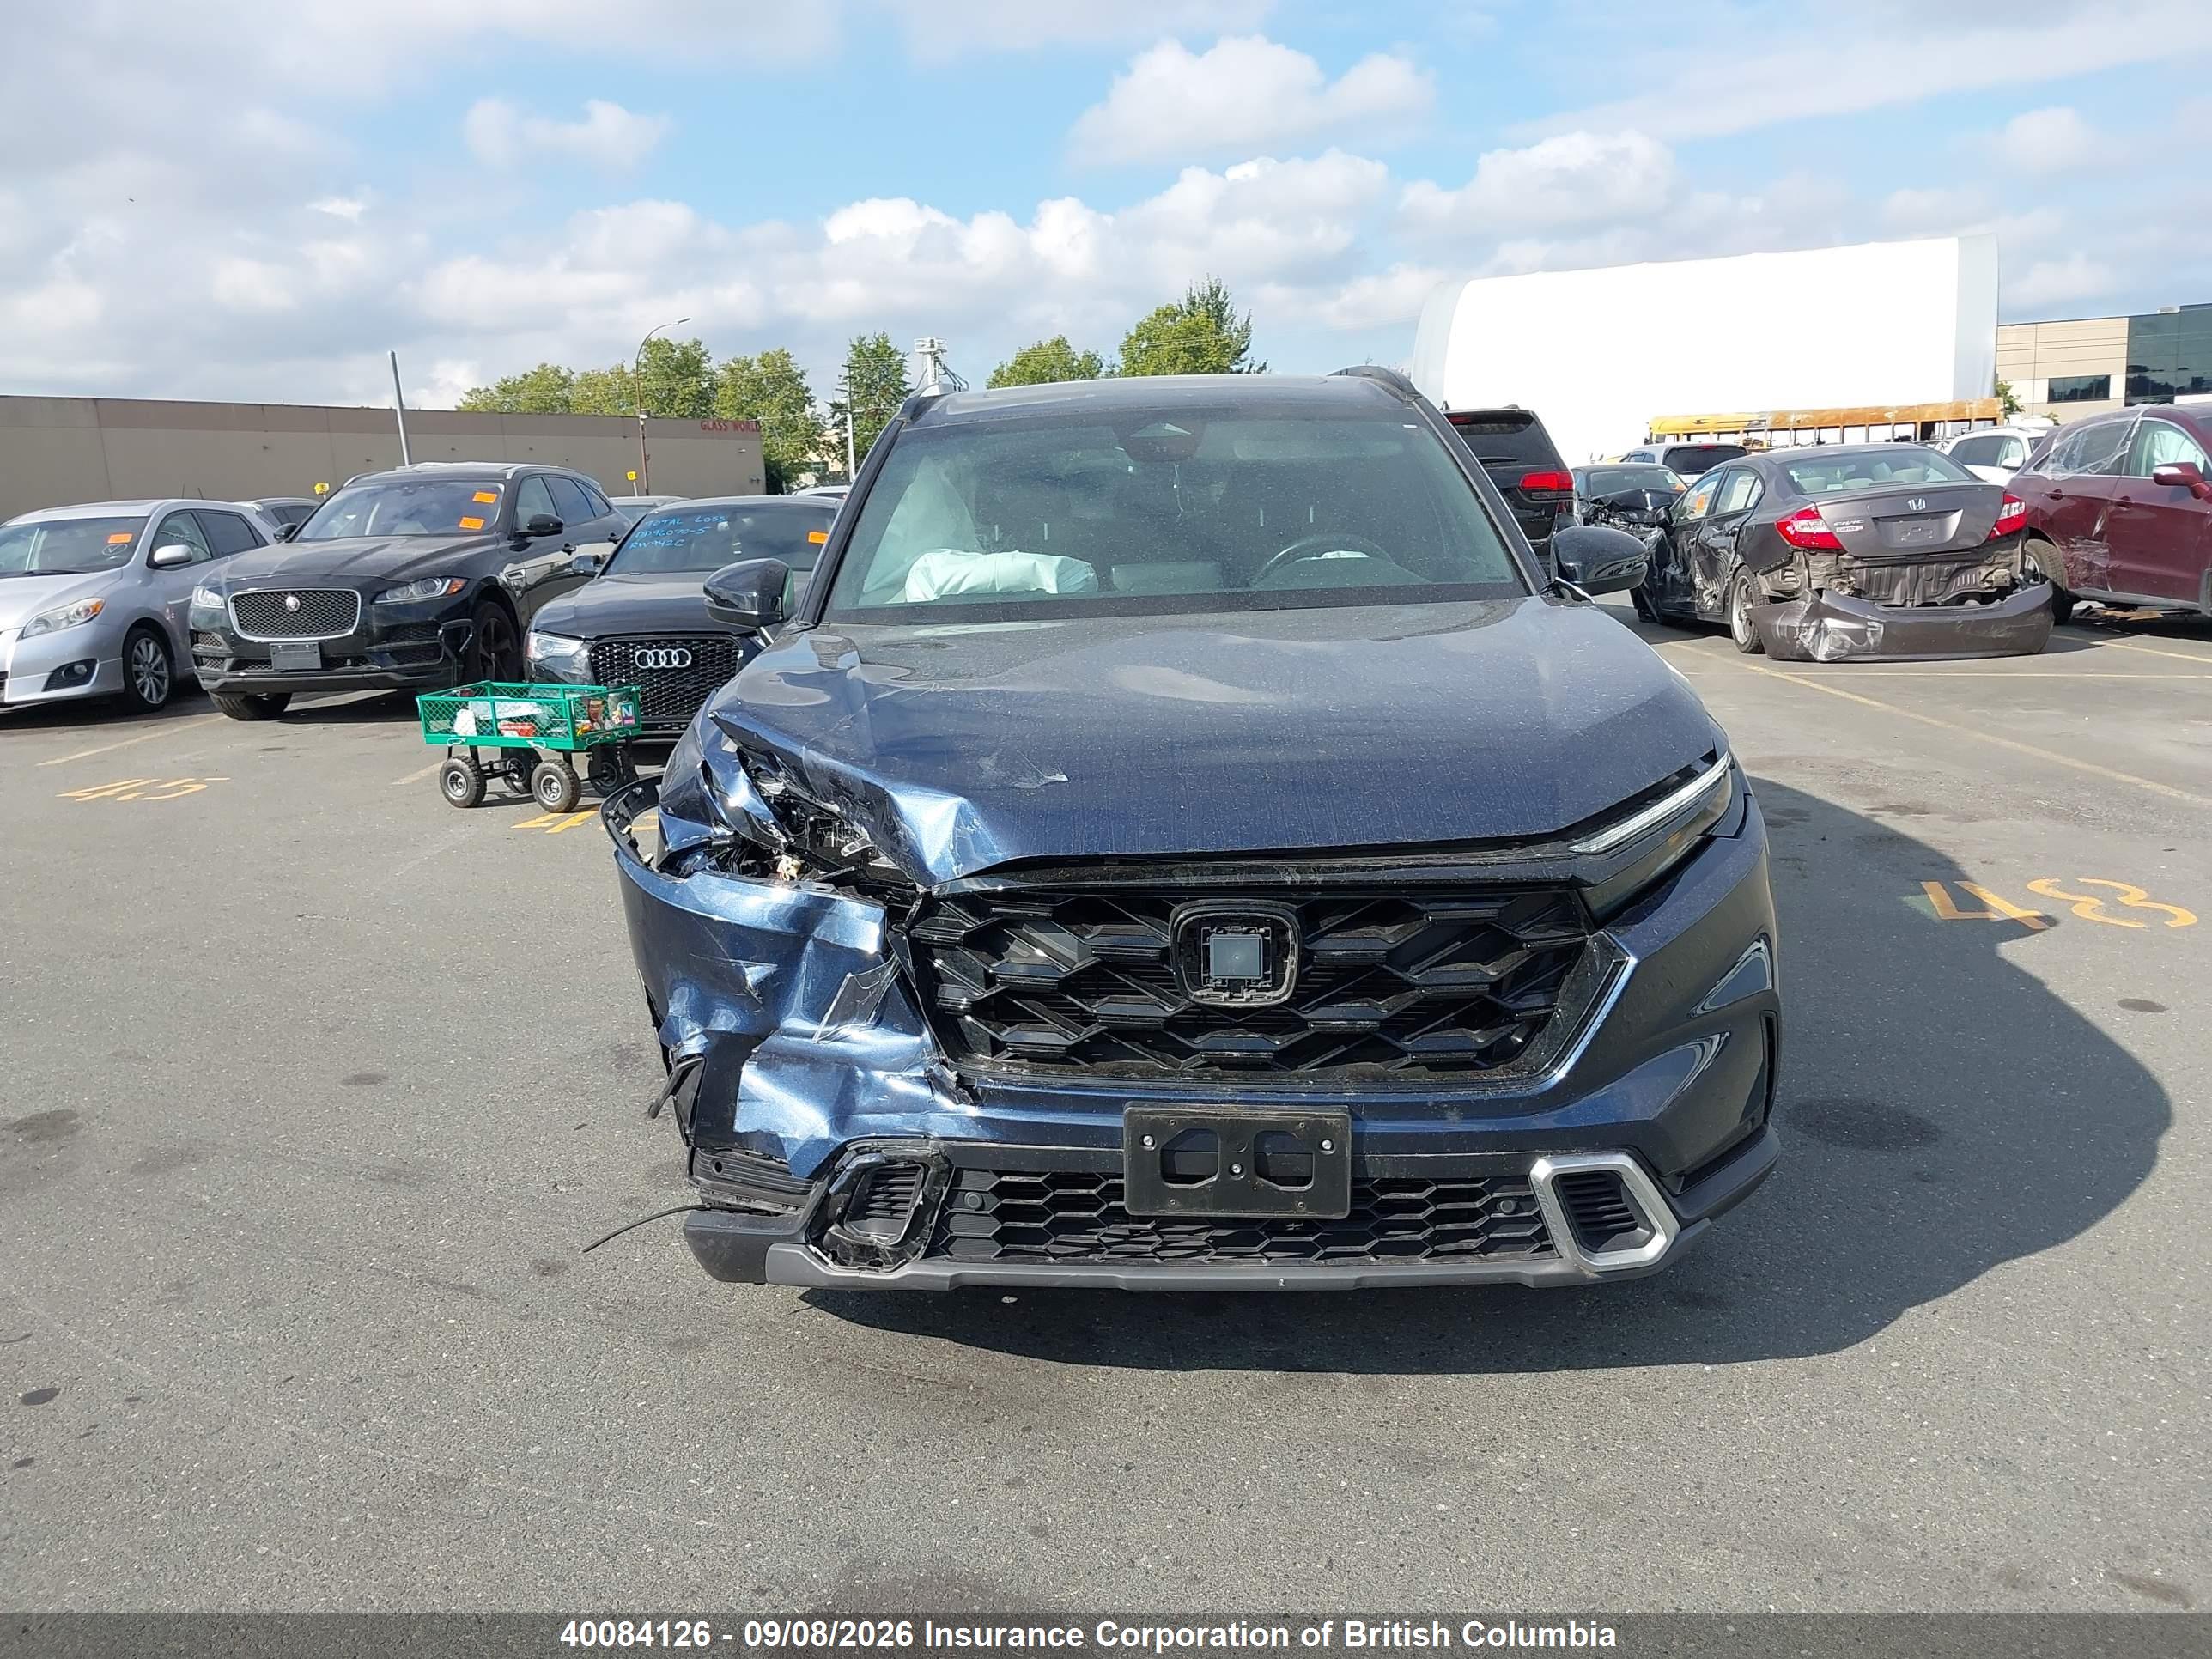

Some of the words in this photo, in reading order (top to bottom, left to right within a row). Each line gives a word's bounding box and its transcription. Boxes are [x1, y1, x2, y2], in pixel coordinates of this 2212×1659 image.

[700, 420, 728, 432] GLASS
[645, 517, 684, 526] TOTAL
[1920, 878, 2198, 930] 48
